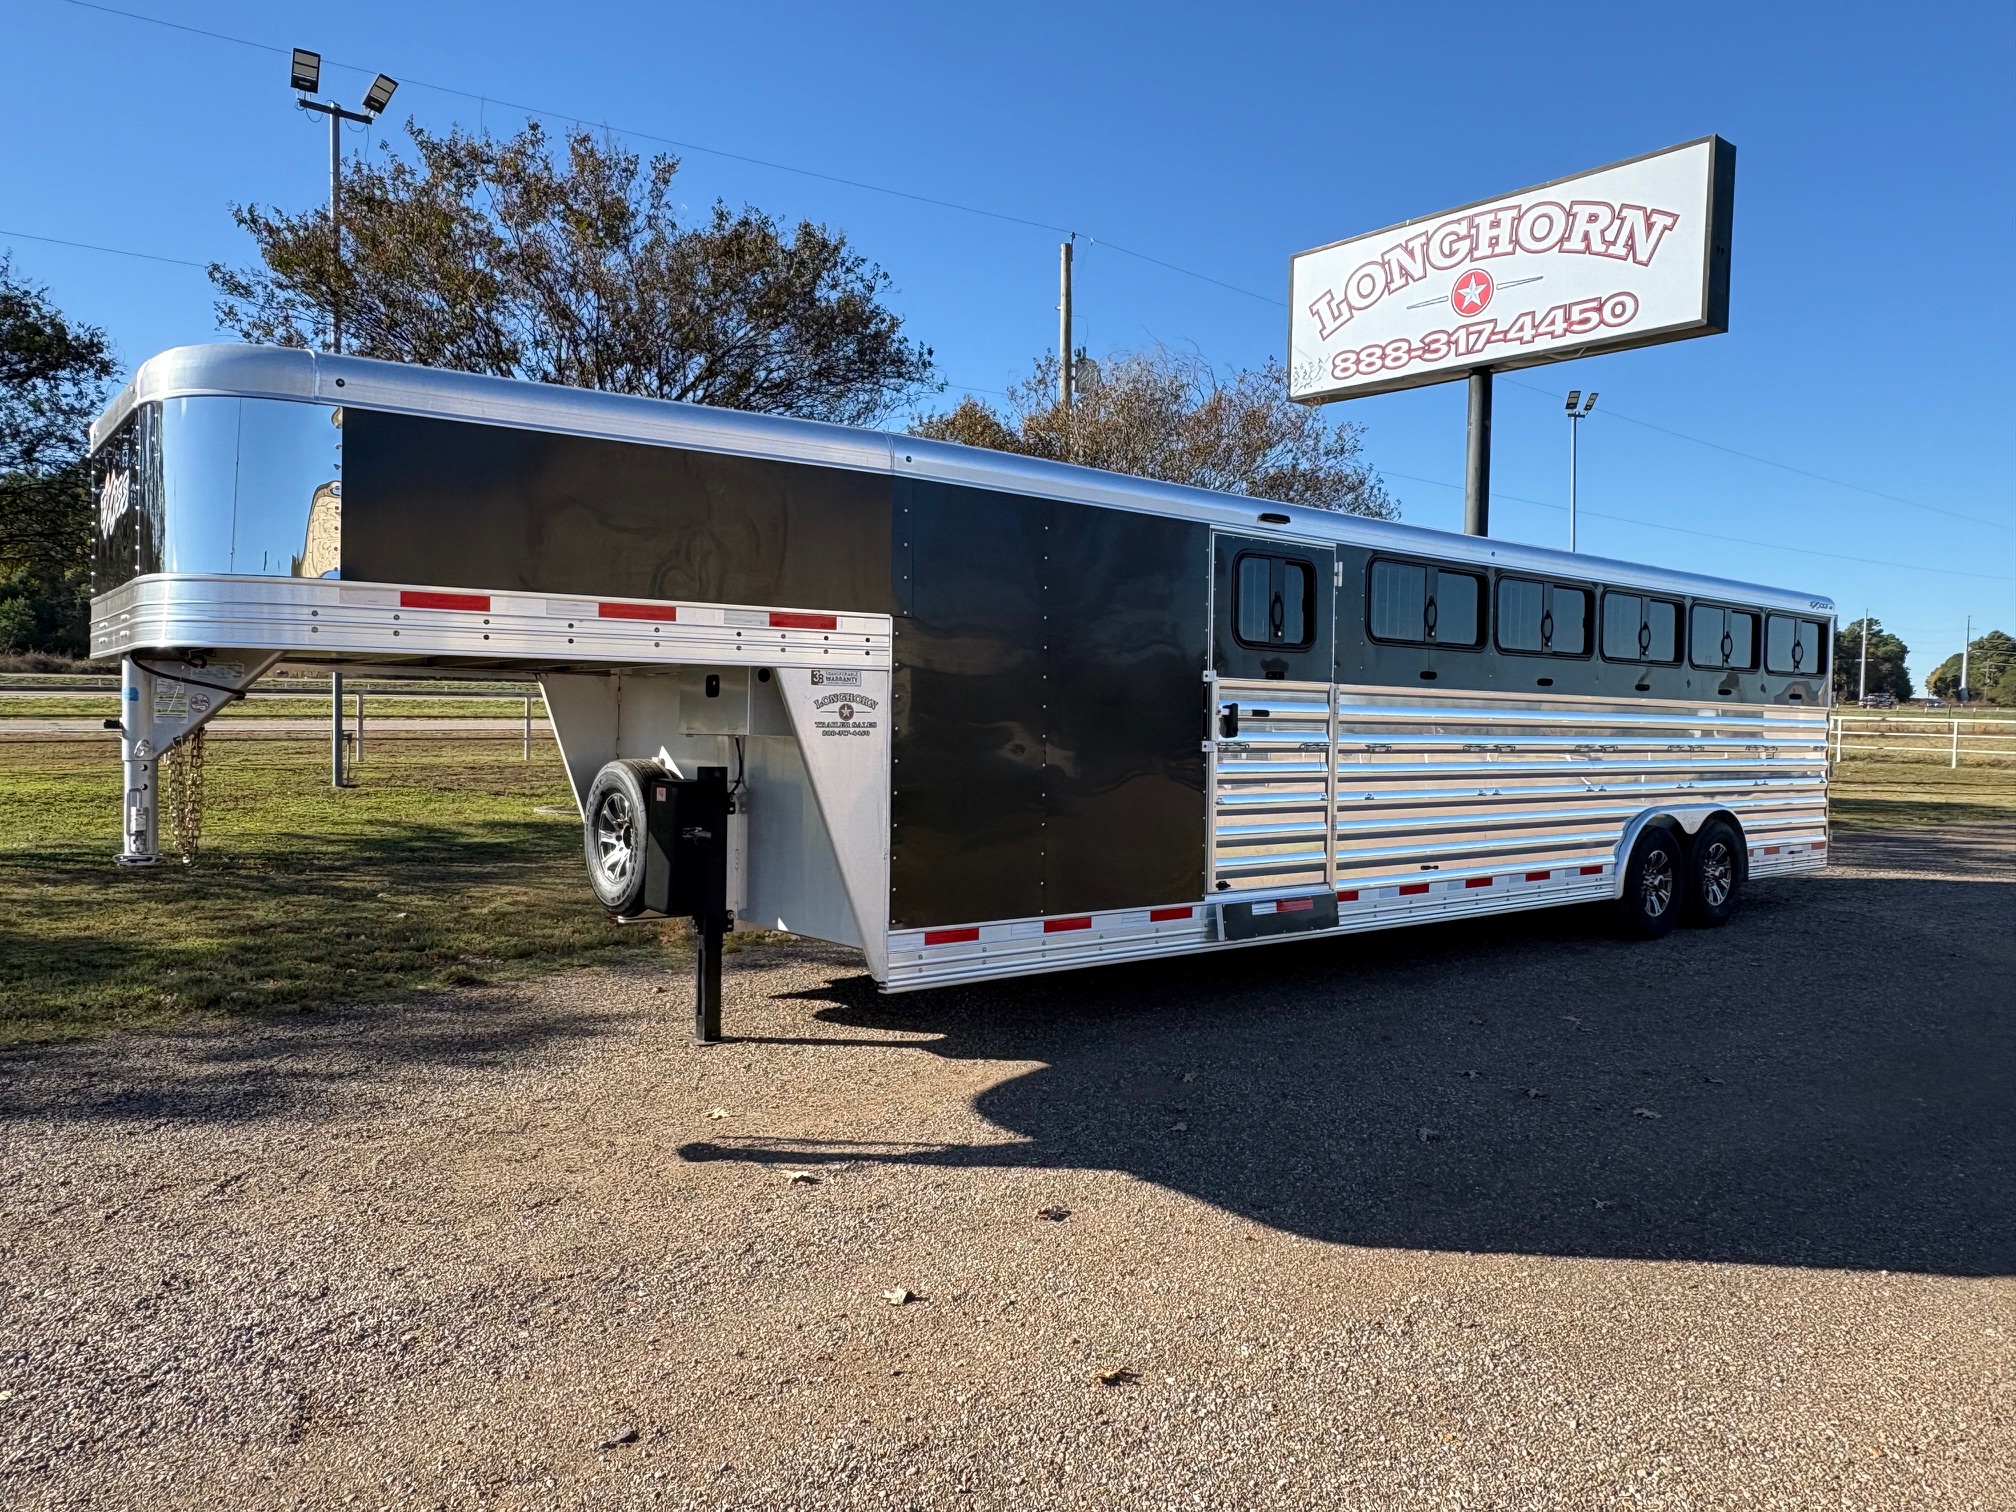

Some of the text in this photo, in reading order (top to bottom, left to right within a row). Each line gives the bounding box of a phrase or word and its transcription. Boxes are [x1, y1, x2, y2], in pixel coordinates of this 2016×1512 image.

[1308, 201, 1680, 341] LONGHORN
[1331, 291, 1639, 380] 888-317-4450
[813, 692, 879, 710] LONGHORN
